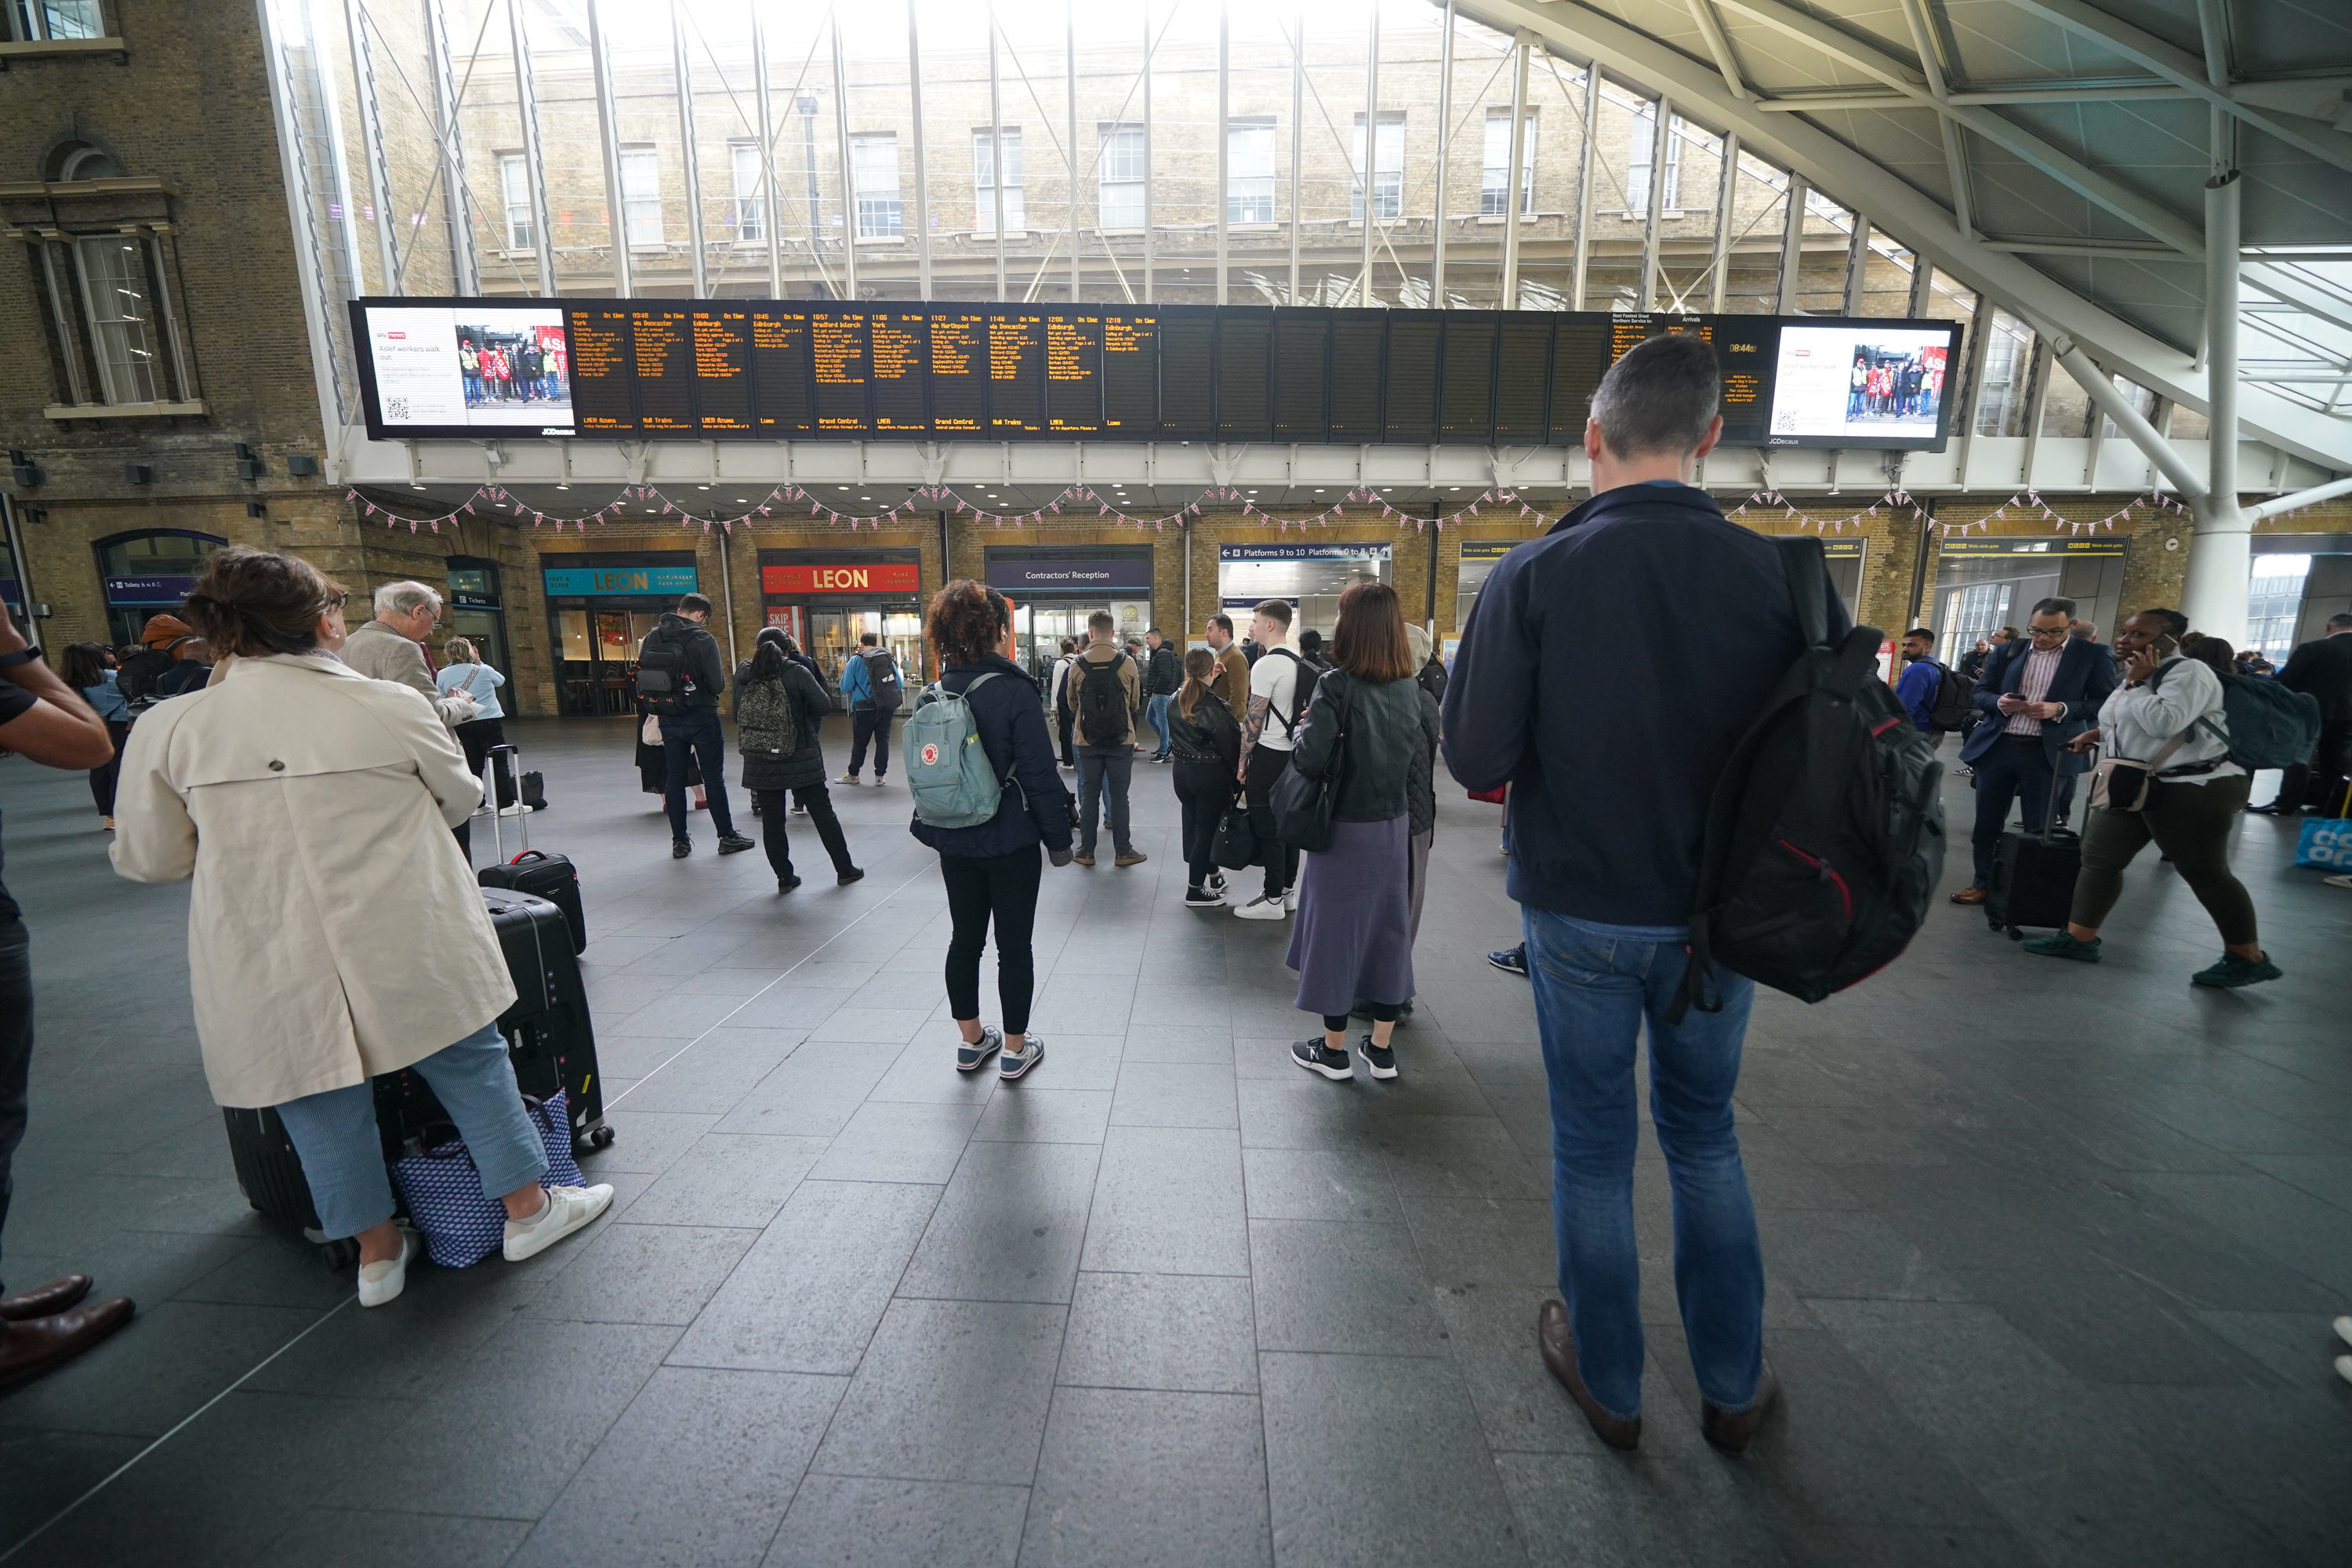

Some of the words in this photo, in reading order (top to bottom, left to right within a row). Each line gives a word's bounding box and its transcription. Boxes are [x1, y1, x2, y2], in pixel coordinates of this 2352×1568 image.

[594, 572, 648, 590] LEON
[813, 569, 869, 589] LEON
[1072, 571, 1109, 579] Reception
[769, 613, 789, 624] SKIP
